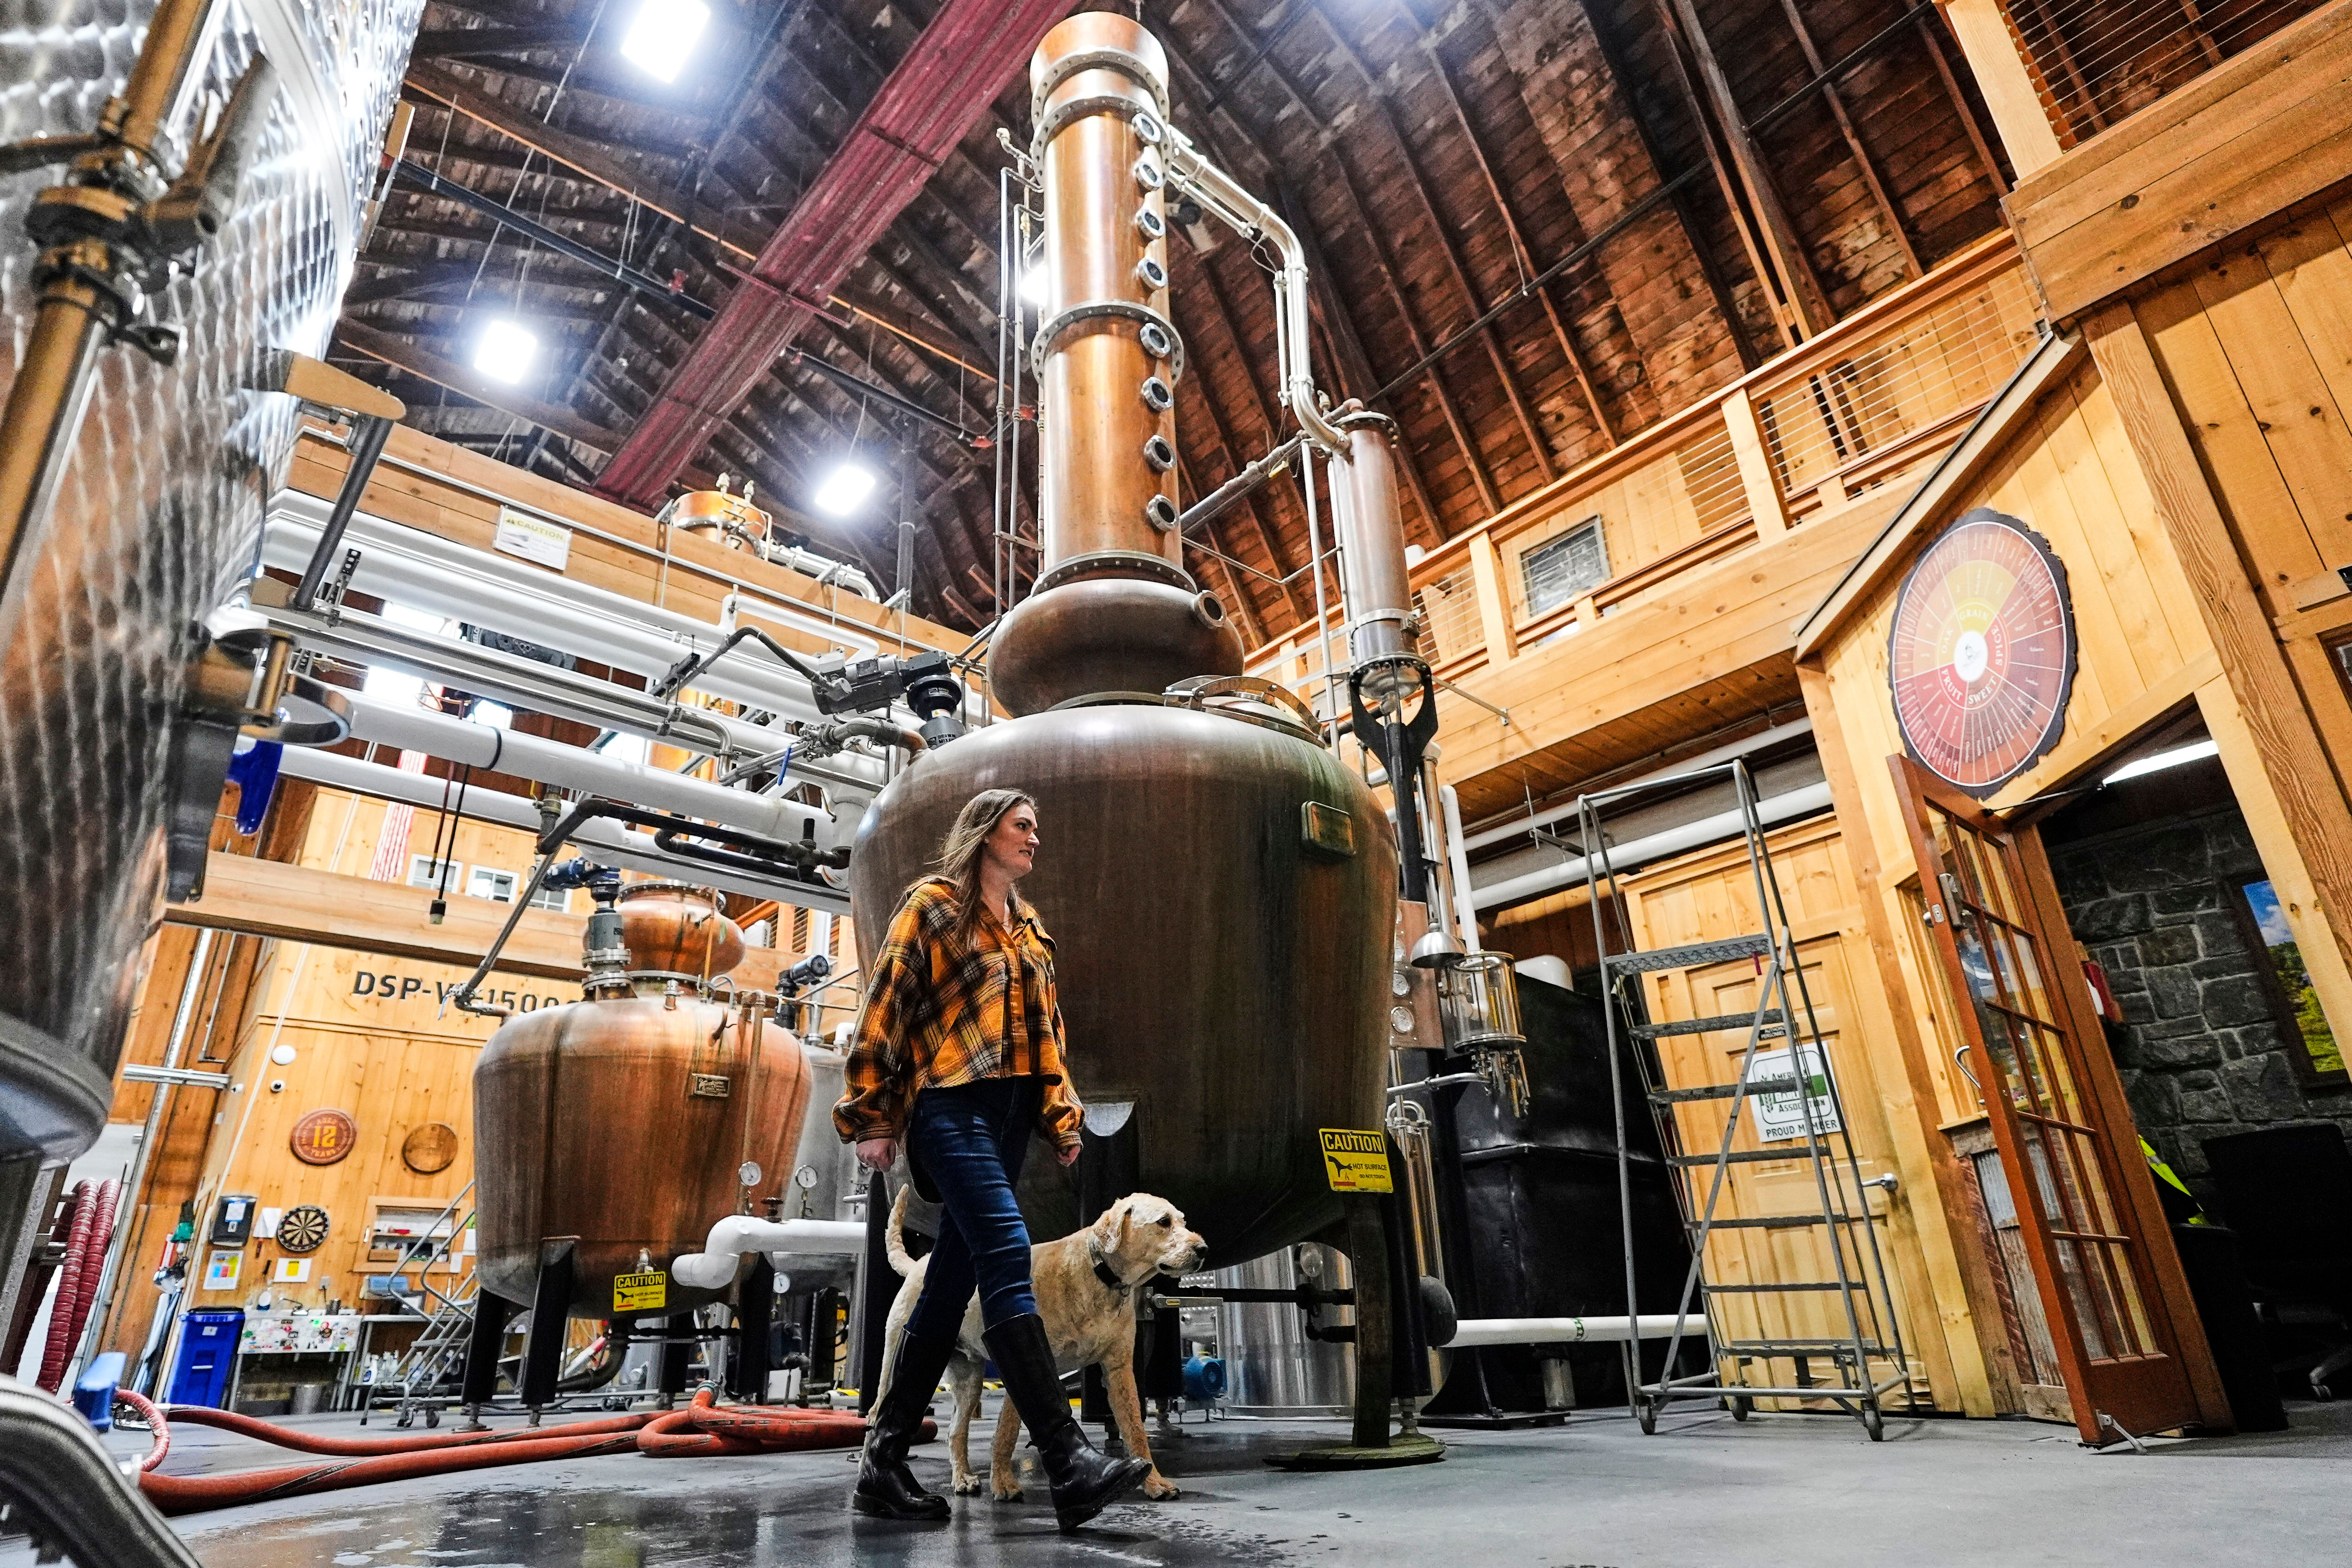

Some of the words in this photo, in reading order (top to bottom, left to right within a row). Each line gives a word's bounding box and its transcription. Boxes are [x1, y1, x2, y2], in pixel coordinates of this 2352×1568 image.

[516, 519, 564, 540] CAUTION
[1960, 609, 1989, 620] GRAIN
[1941, 628, 1953, 654] OAK
[1991, 625, 2004, 666] SPICE
[1941, 668, 1964, 701] FRUIT
[1968, 675, 1997, 706] SWEET
[312, 1125, 337, 1148] 12
[1766, 1126, 1795, 1138] PROUD
[1325, 1134, 1383, 1153] CAUTION
[617, 1275, 663, 1288] CAUTION
